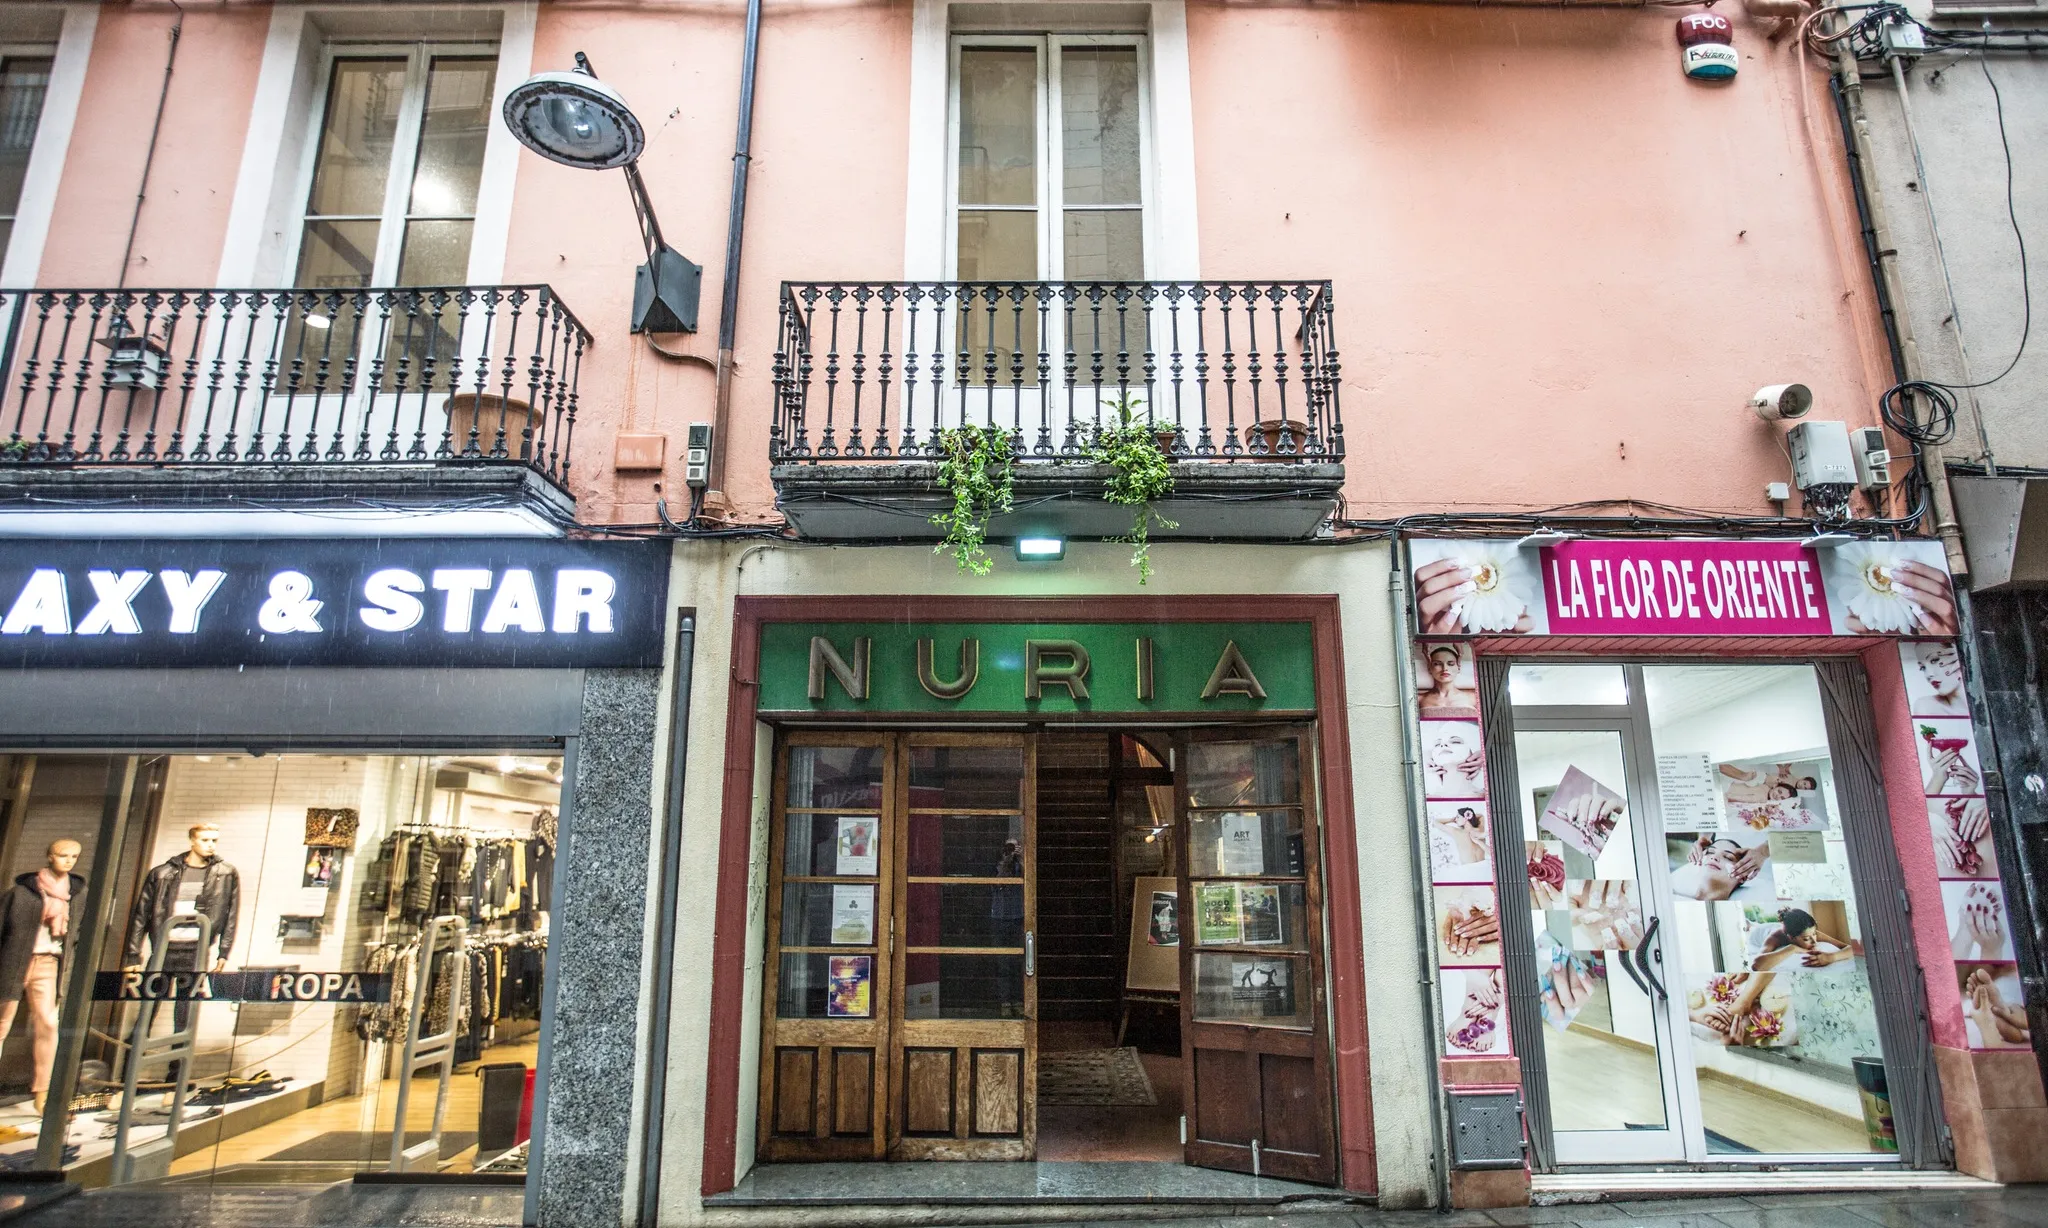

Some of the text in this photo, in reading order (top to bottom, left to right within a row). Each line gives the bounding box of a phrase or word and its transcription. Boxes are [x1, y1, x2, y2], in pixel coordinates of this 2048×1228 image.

[1691, 16, 1727, 30] FOC
[0, 567, 616, 634] AXY & STAR
[1552, 558, 1819, 619] LA FLOR DE ORIENTE
[808, 636, 1268, 700] NURIA
[119, 972, 364, 1000] ROPA ROPA
